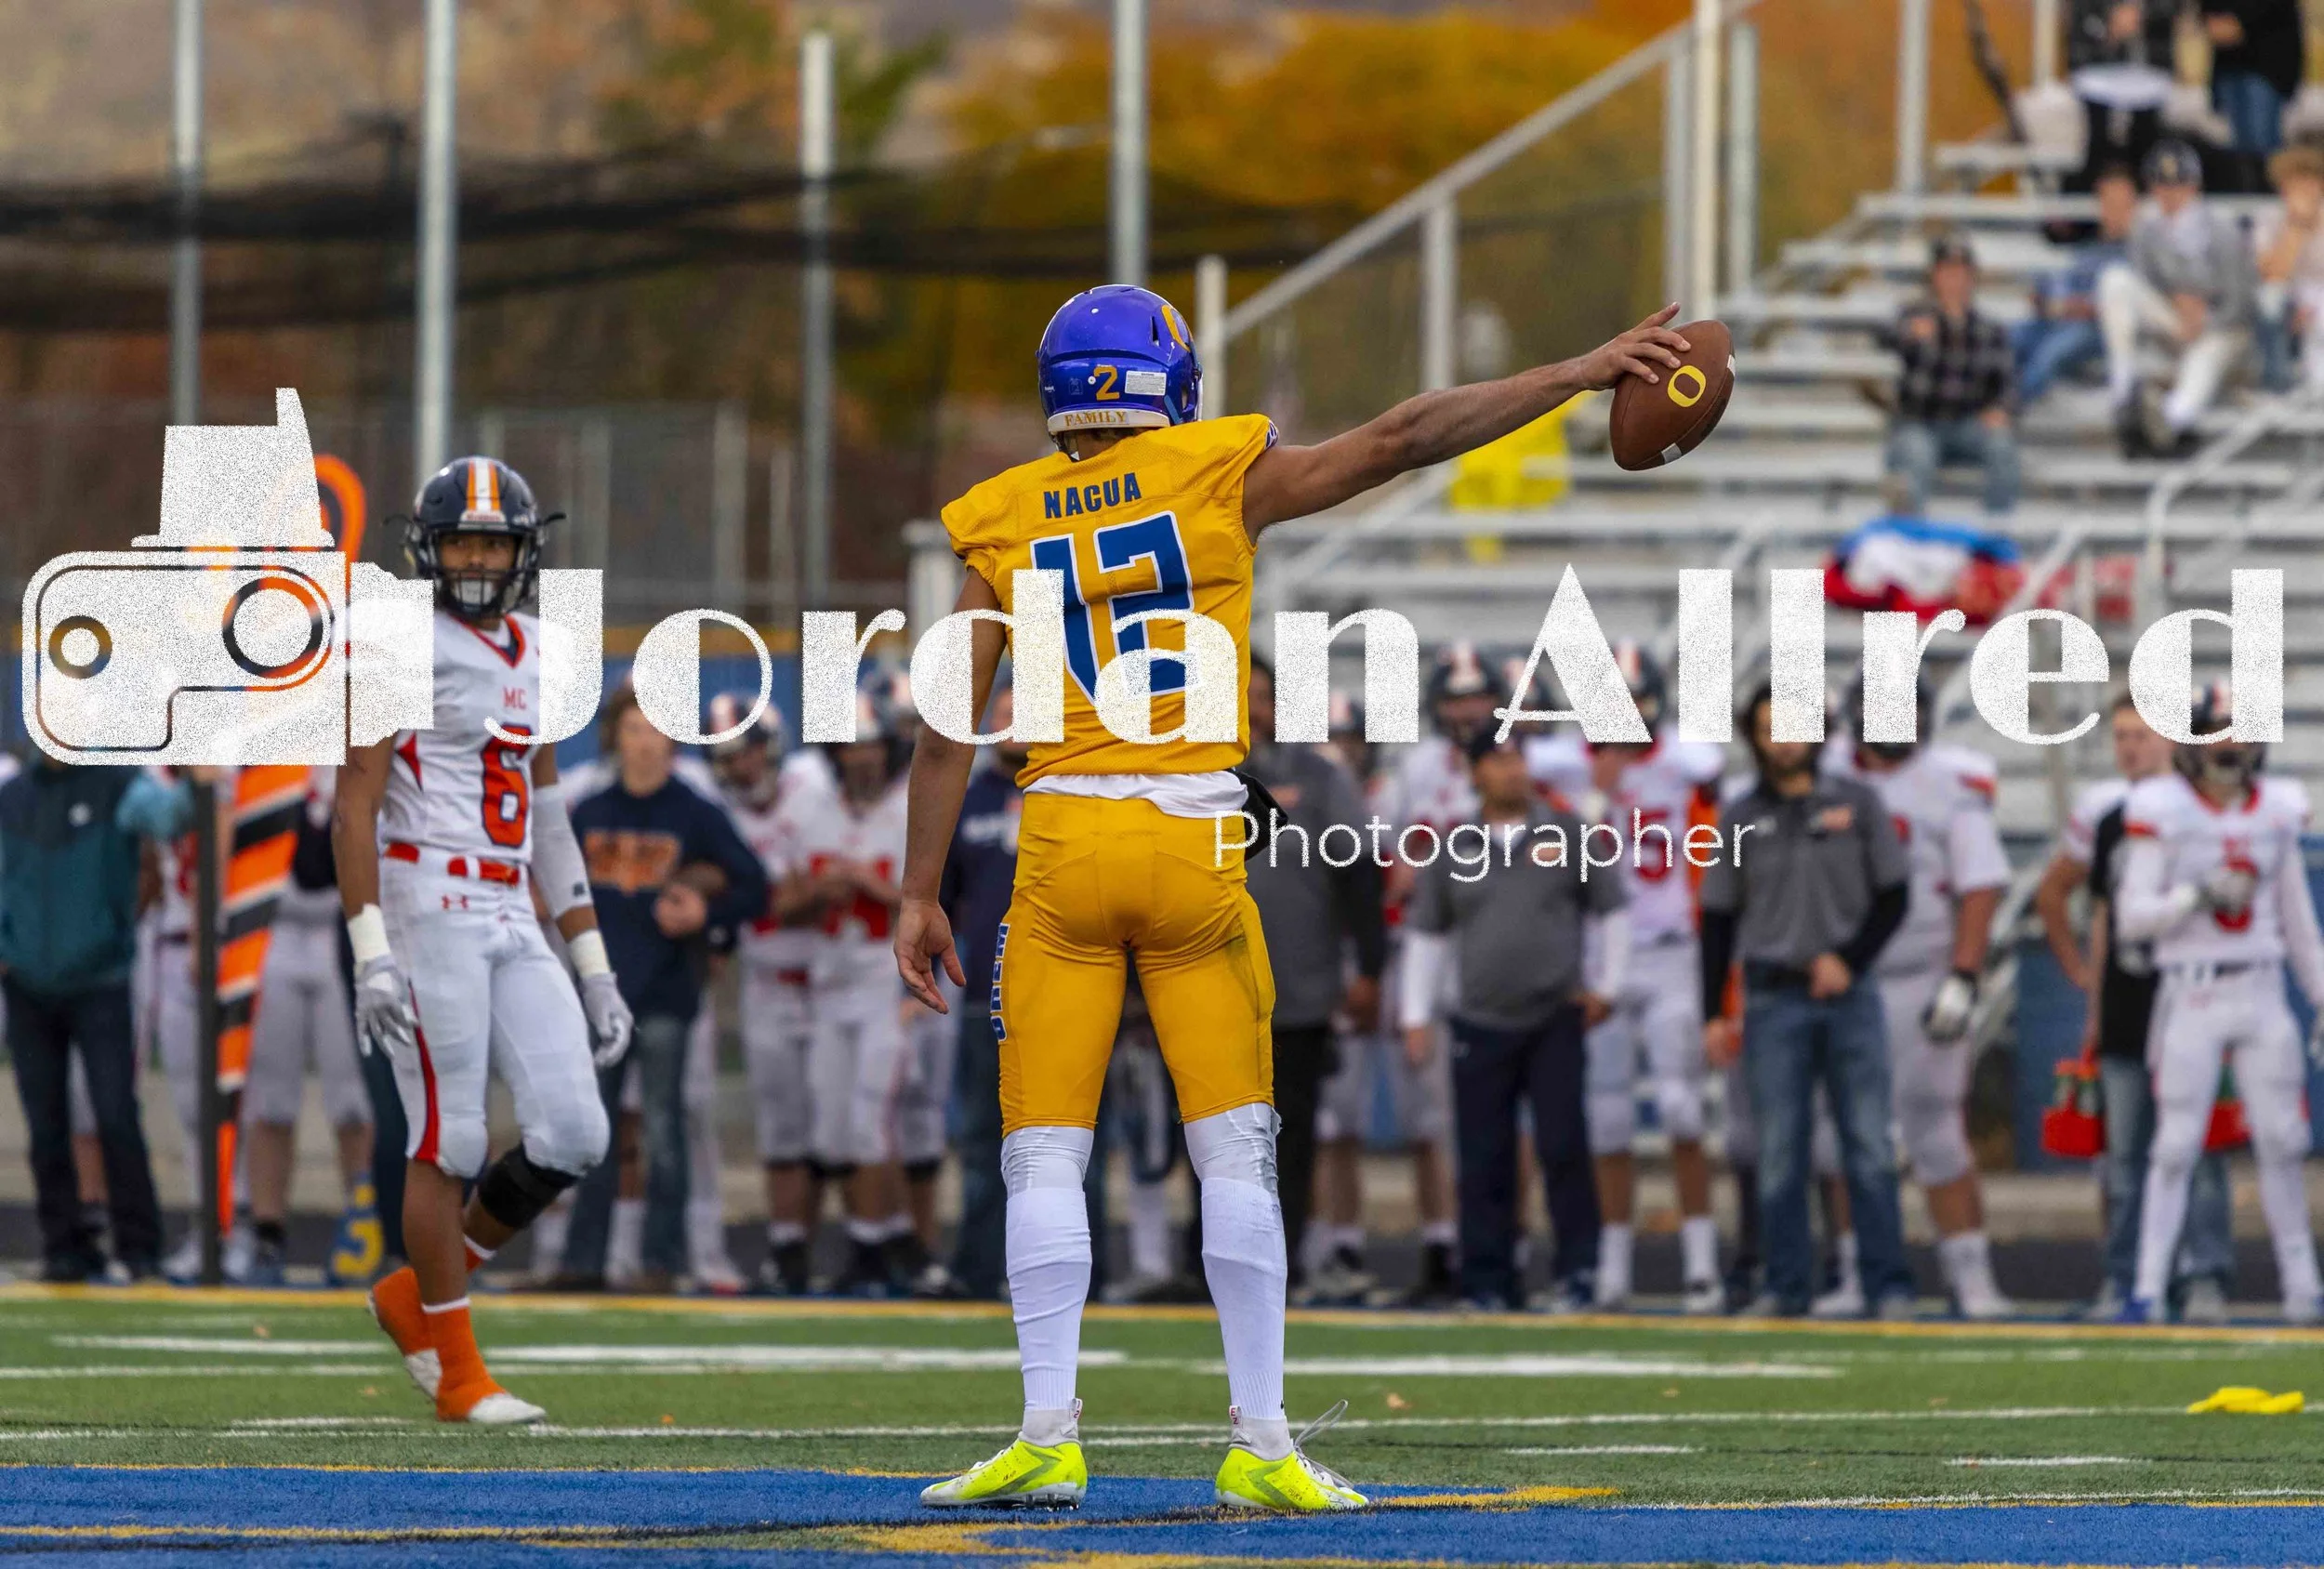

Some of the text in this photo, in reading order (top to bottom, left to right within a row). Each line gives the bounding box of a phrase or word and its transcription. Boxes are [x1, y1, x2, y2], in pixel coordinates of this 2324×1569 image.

[1093, 364, 1120, 401] 2
[1667, 364, 1707, 408] O
[1064, 411, 1128, 427] FAMILY
[1043, 472, 1142, 519] NACUA
[1029, 509, 1200, 707] 12
[503, 686, 527, 711] MC
[480, 721, 530, 850] 6
